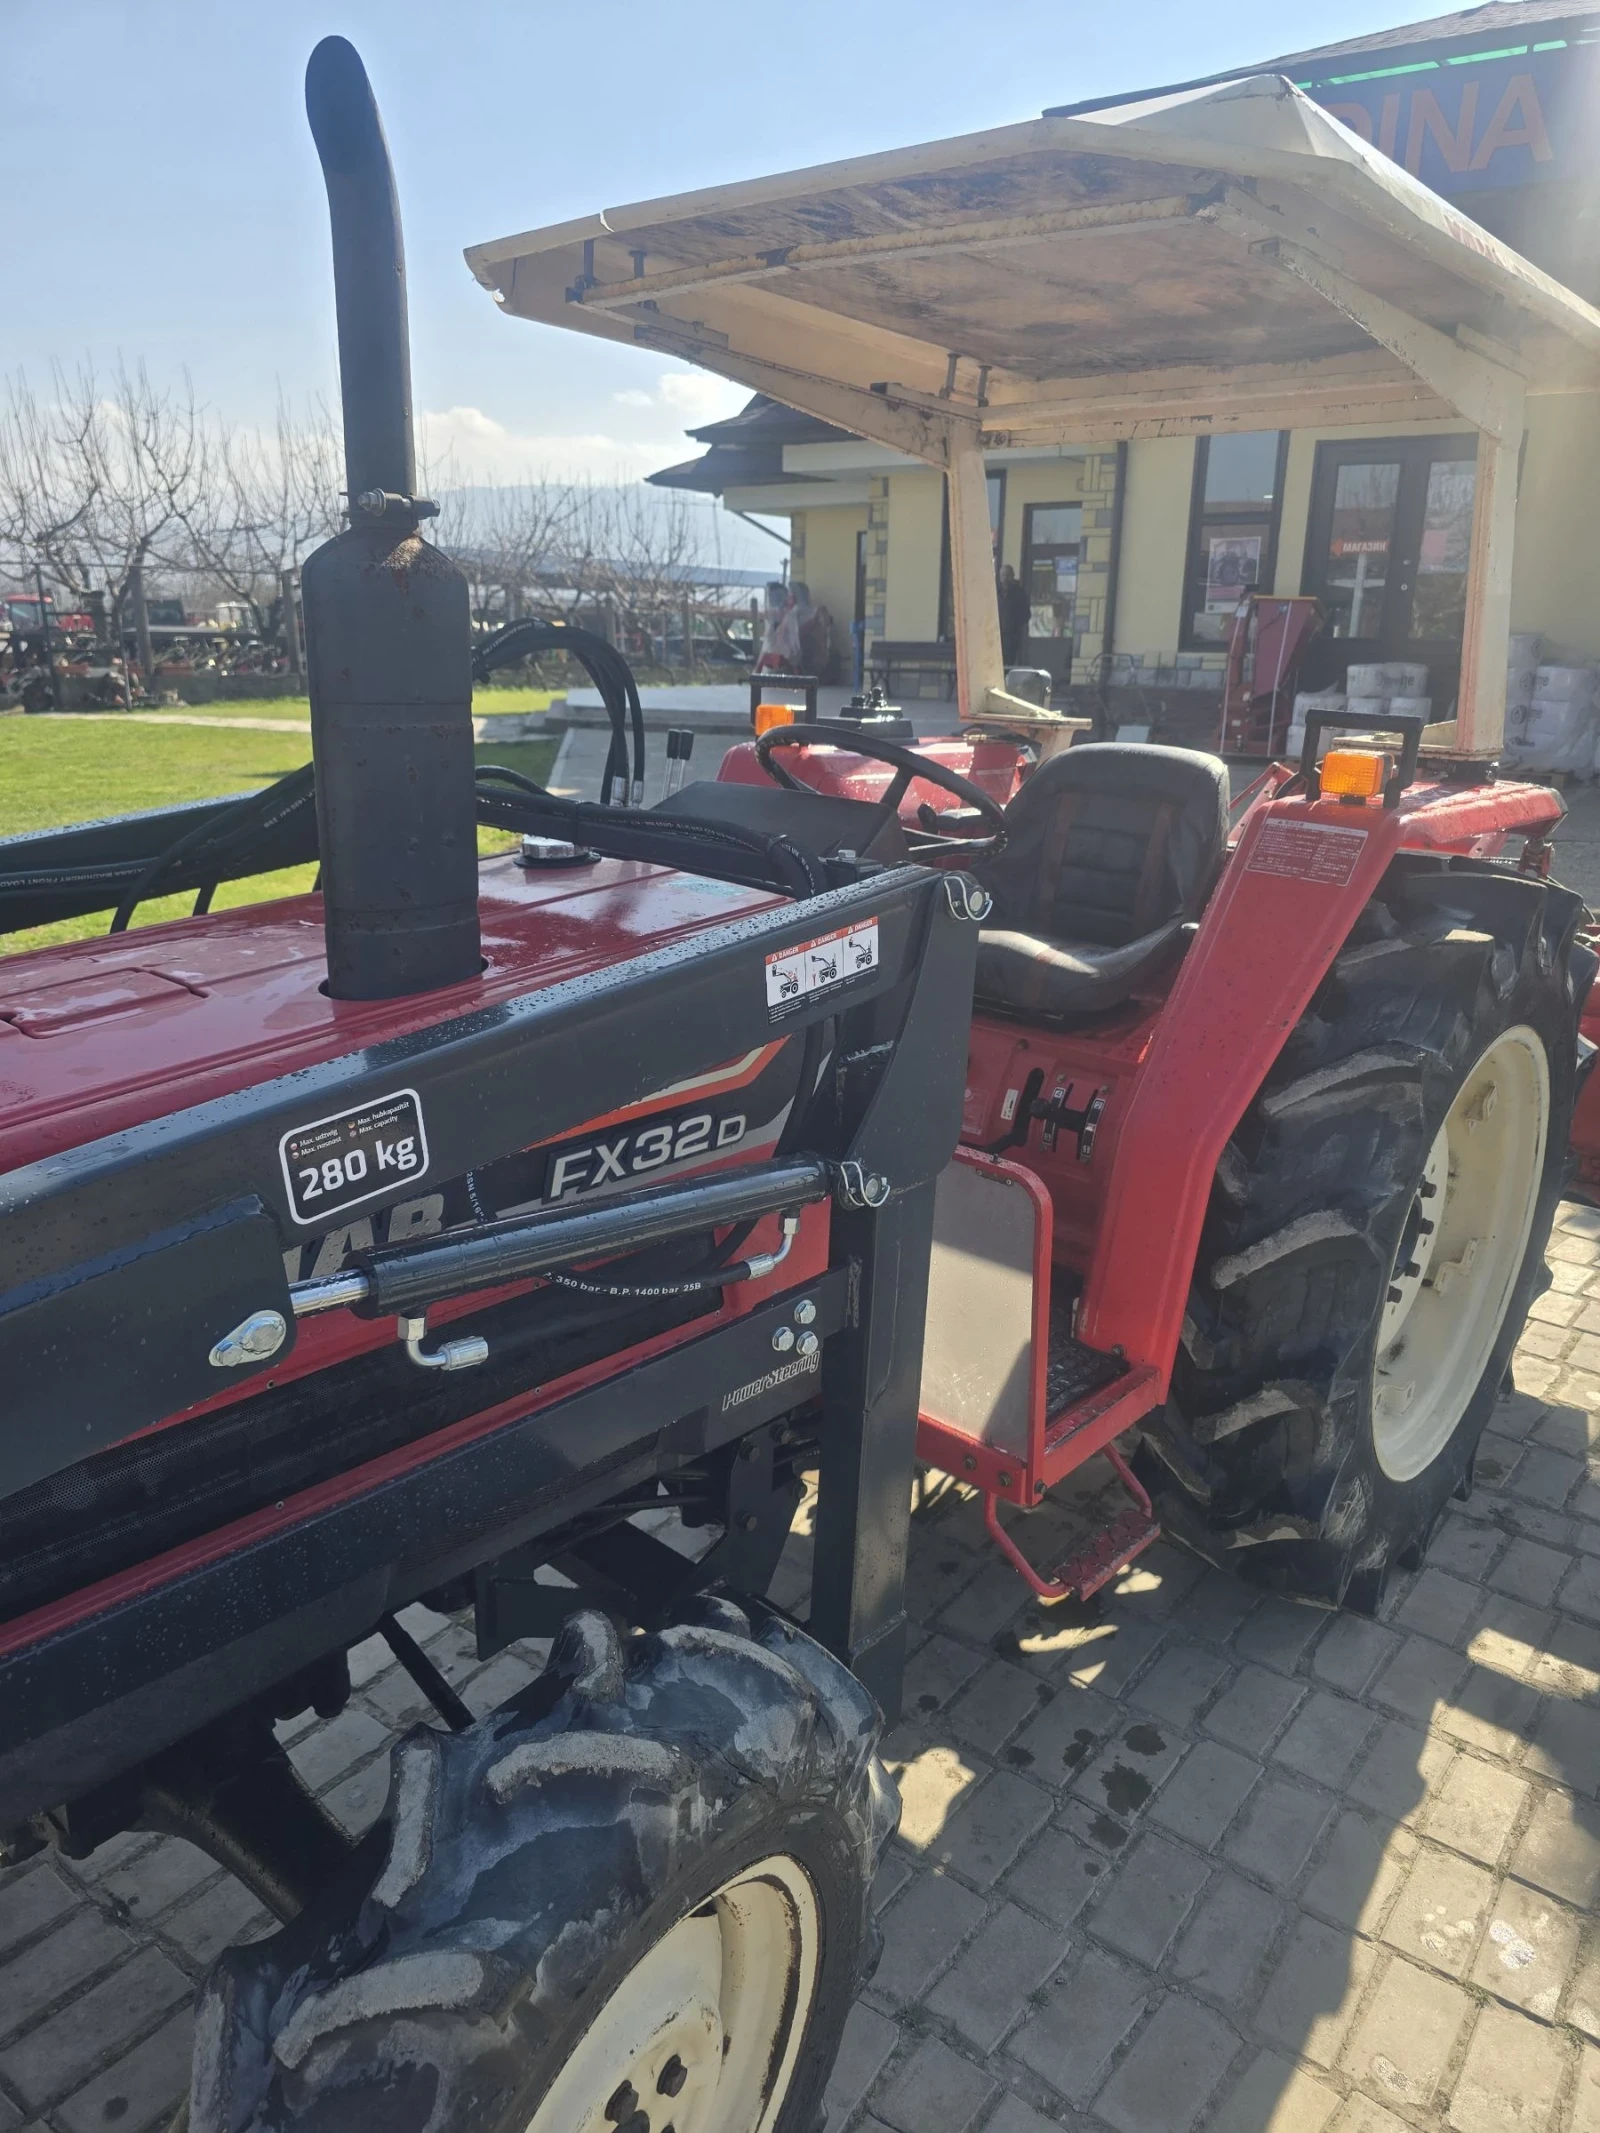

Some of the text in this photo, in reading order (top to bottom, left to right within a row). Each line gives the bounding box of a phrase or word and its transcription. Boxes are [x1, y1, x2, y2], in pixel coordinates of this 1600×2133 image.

[1343, 541, 1387, 552] МАГАЗИН
[854, 919, 873, 932] DANGER
[816, 932, 837, 945] DANGER
[778, 946, 799, 959] DANGER
[357, 1116, 372, 1126] Max.
[359, 1115, 399, 1135] Max. capacity
[299, 1138, 315, 1147] Max.
[301, 1146, 316, 1156] Max.
[298, 1136, 418, 1202] 280 kg
[556, 1275, 578, 1288] 350
[580, 1282, 600, 1293] bar
[609, 1287, 631, 1296] B.P.
[634, 1287, 660, 1296] 1400
[661, 1286, 680, 1295] bar
